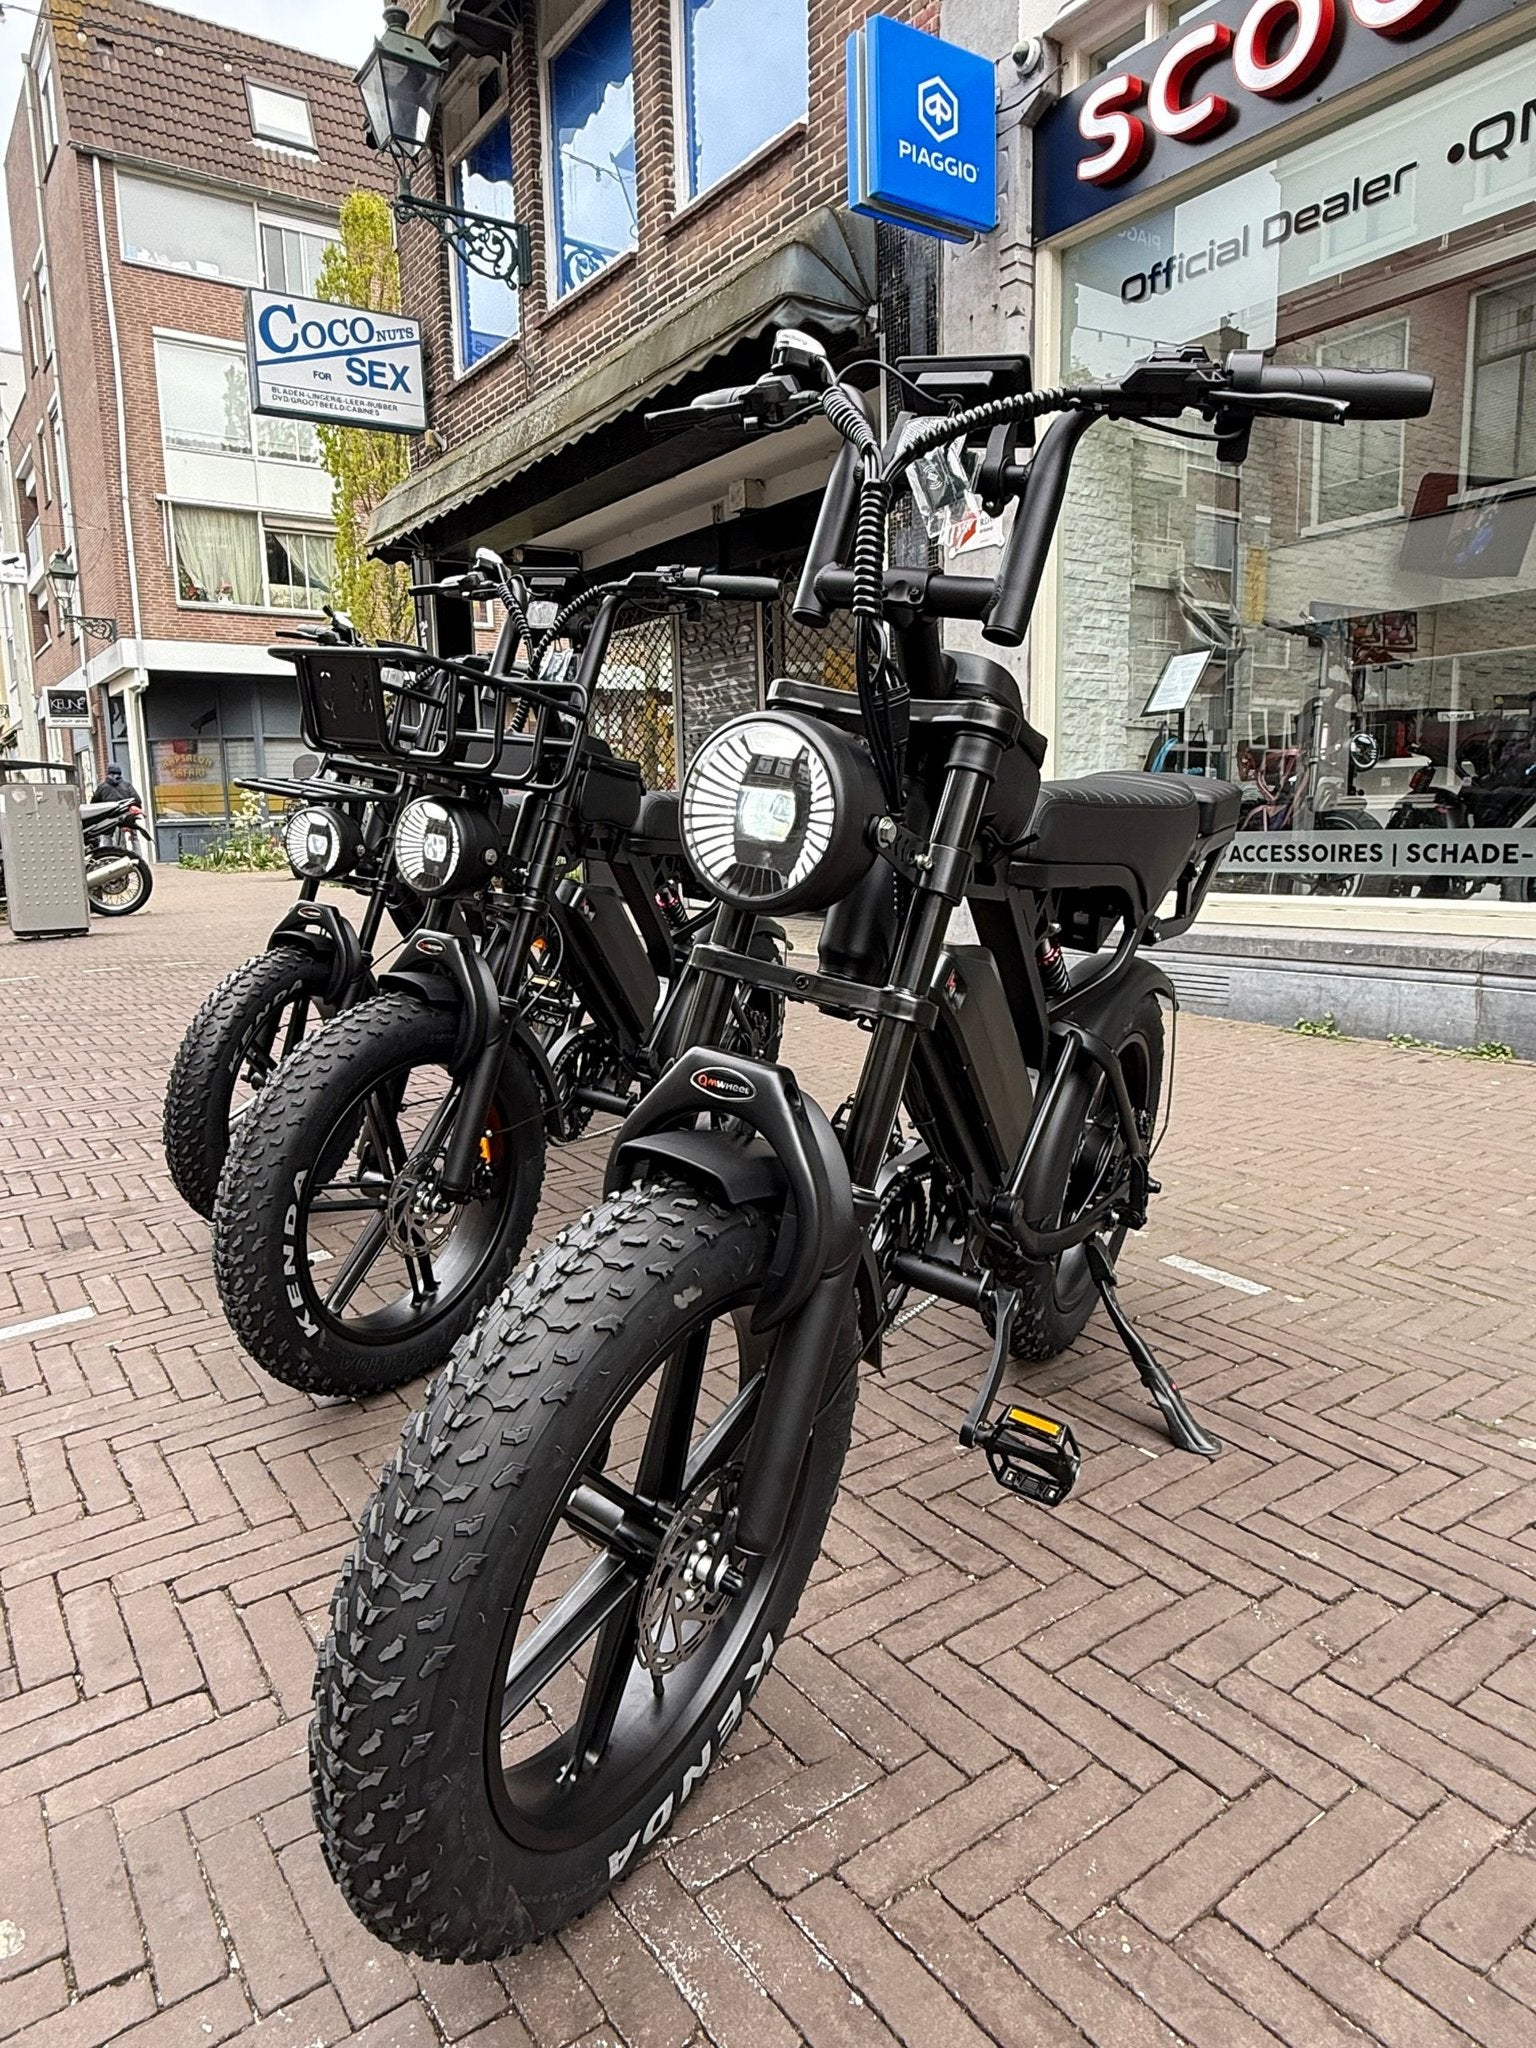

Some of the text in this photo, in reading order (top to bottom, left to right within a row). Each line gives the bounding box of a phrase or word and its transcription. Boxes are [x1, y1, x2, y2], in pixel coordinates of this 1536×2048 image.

[899, 139, 978, 183] PIAGGIO
[1121, 224, 1249, 303] Official
[1262, 161, 1418, 249] Dealer
[313, 357, 412, 393] FOR SEX
[1228, 843, 1383, 863] ACCESSOIRES
[1406, 843, 1534, 864] SCHADE-
[283, 1169, 320, 1338] KENDA
[608, 1632, 775, 1880] KENDA
